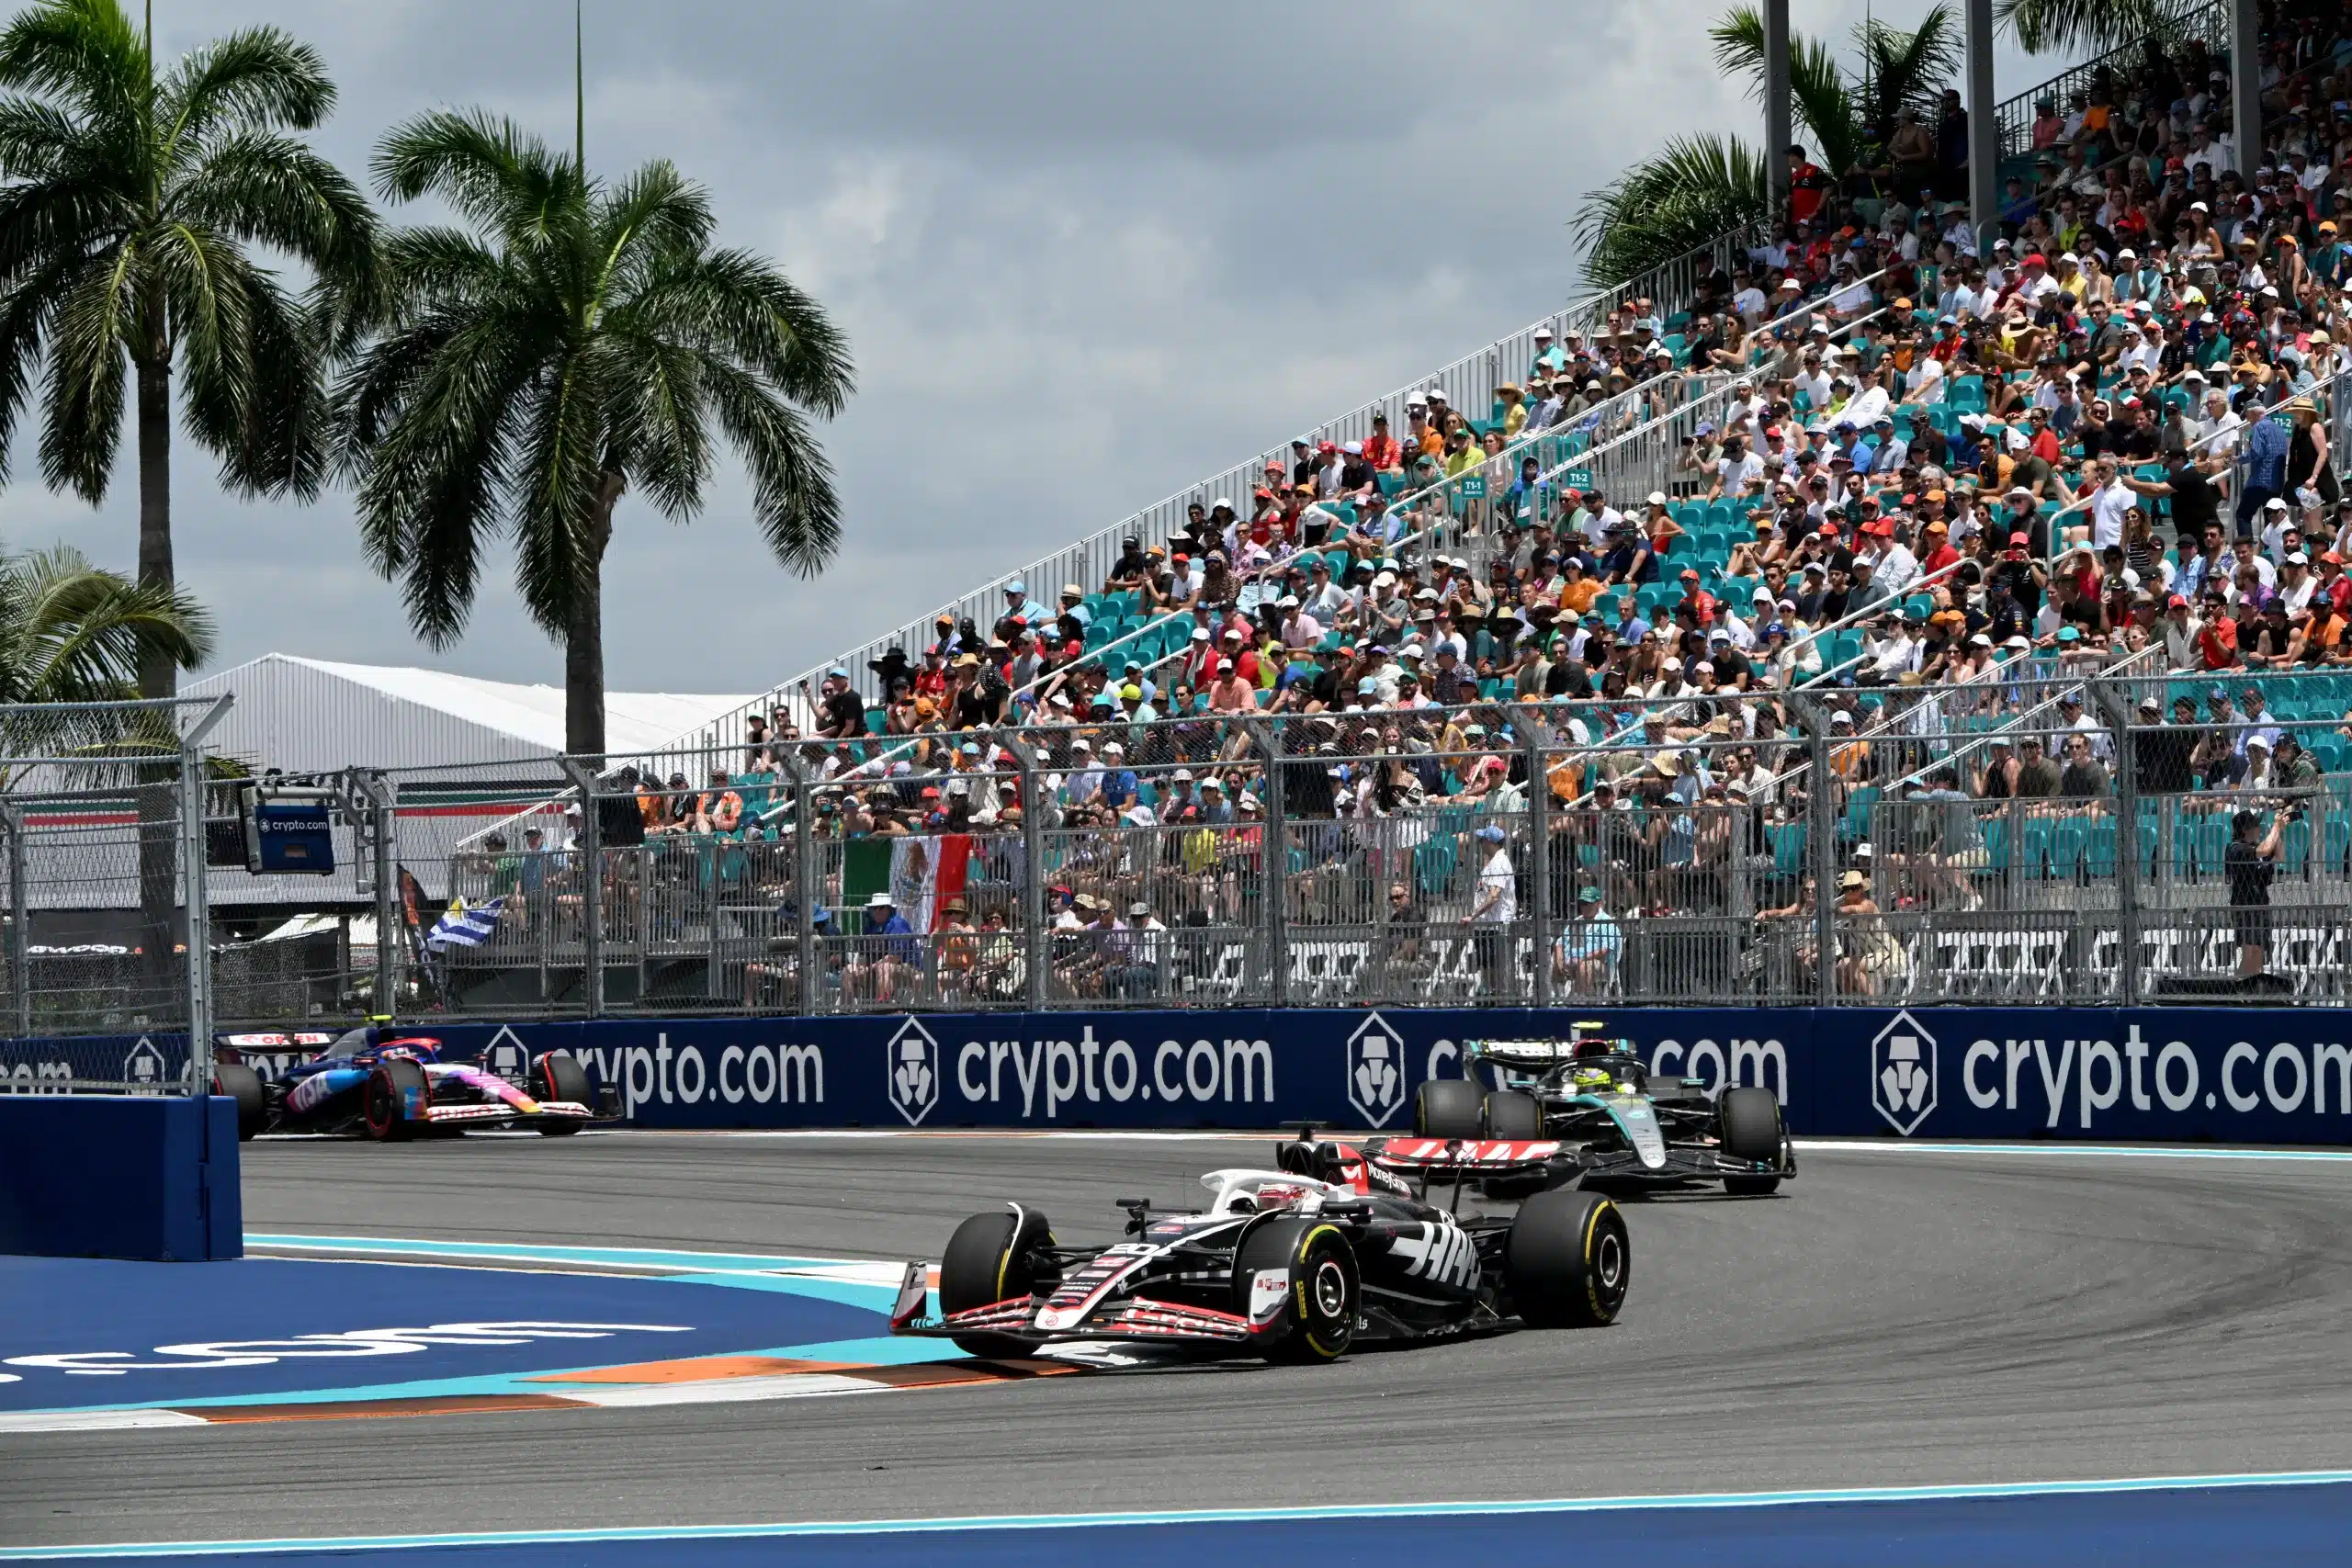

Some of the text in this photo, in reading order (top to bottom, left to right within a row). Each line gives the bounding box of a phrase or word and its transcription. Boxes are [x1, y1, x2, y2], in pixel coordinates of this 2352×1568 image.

[1570, 473, 1589, 482] T1-2
[1464, 481, 1481, 490] T1-1
[272, 819, 328, 832] crypto.com
[957, 1025, 1274, 1118] crypto.com
[1366, 1160, 1412, 1195] MoneyGram
